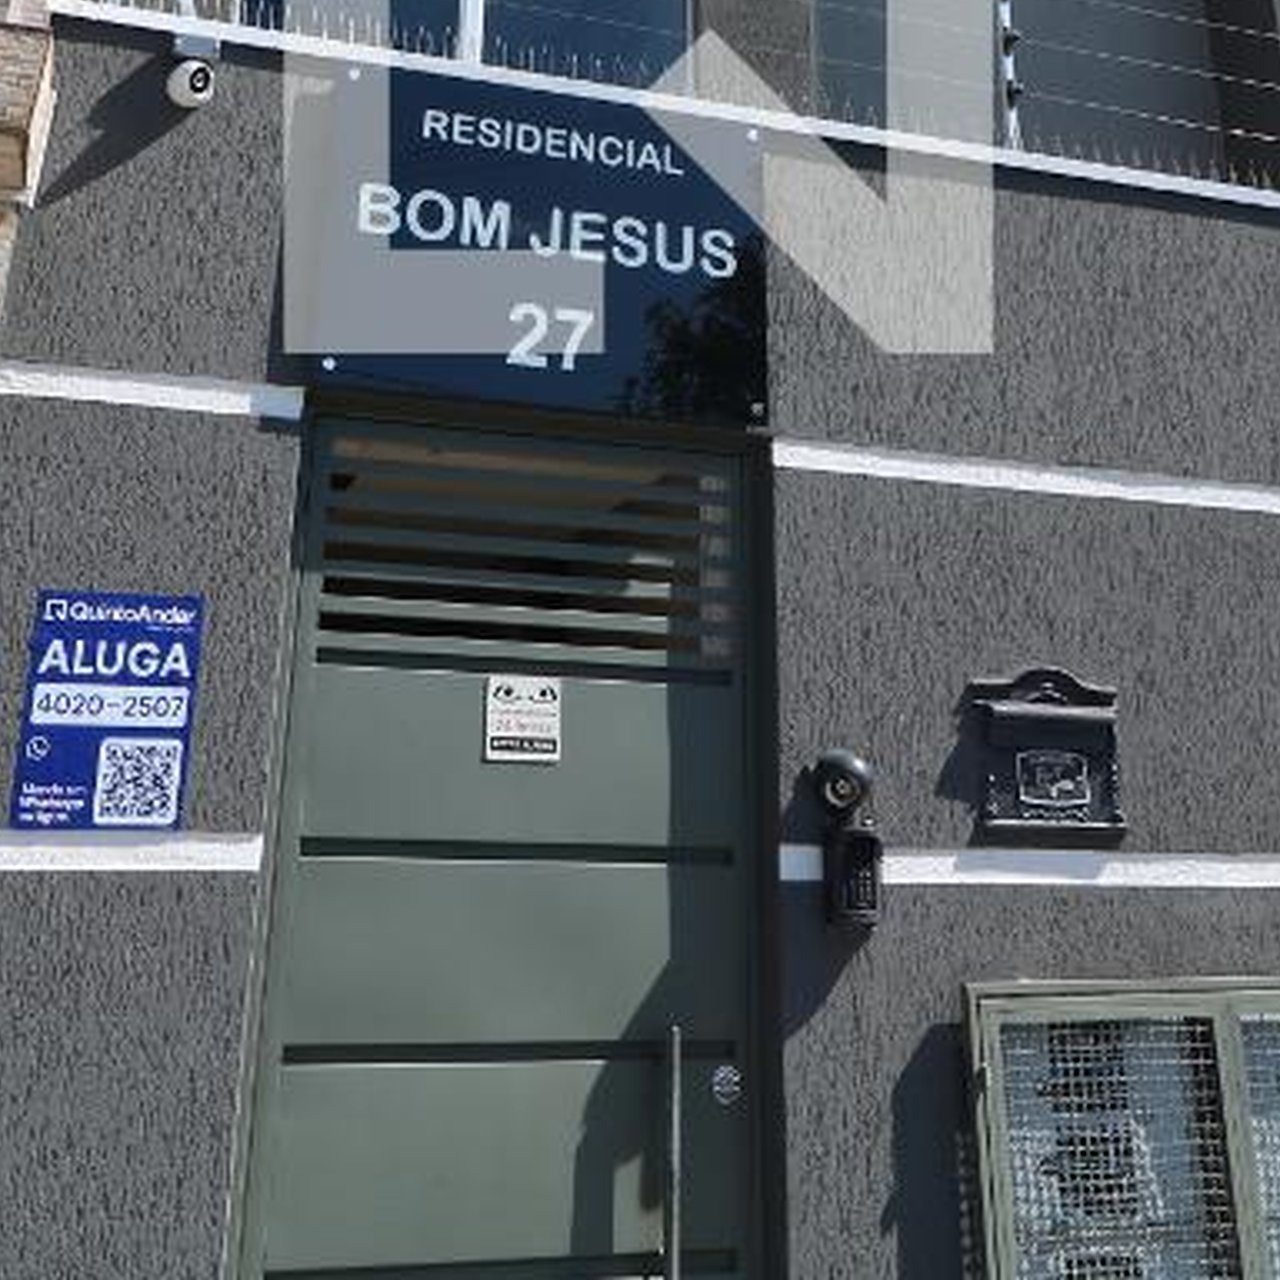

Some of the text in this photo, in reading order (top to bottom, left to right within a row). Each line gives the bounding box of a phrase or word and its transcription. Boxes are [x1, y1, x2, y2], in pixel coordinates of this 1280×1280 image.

[422, 109, 685, 176] RESIDENCIAL
[357, 182, 739, 280] BOM JESUS
[505, 302, 595, 371] 27
[36, 639, 191, 678] ALUGA
